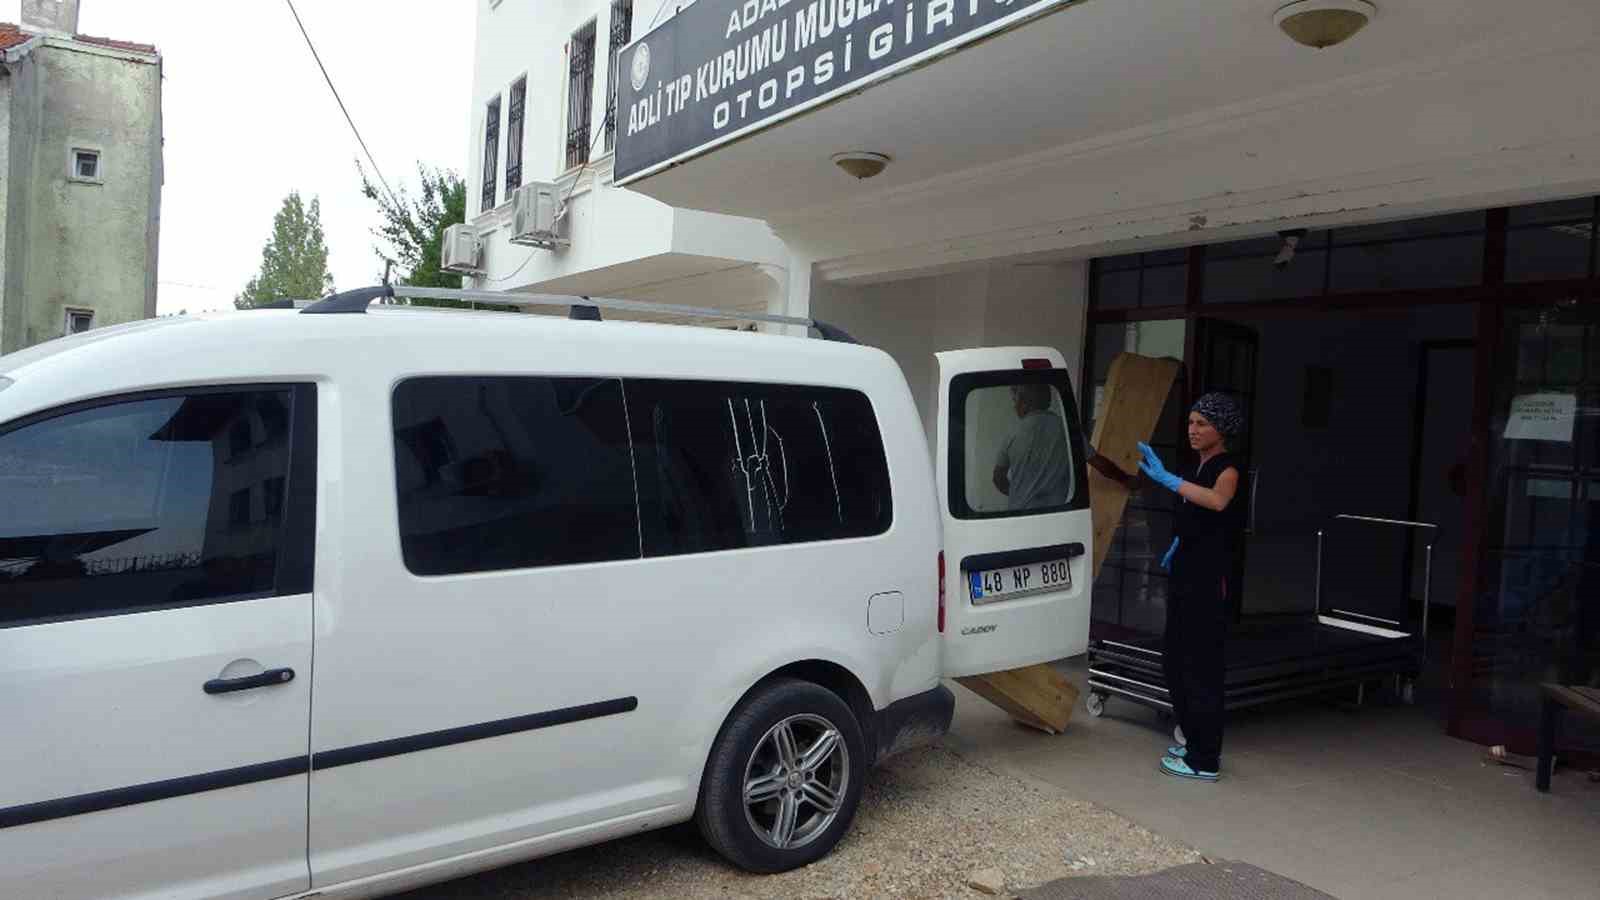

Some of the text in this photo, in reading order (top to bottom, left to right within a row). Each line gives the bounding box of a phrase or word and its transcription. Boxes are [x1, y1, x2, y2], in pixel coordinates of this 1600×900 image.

[627, 80, 662, 137] ADLİ
[665, 73, 693, 117] TIP
[695, 18, 788, 103] KURUMU
[712, 33, 852, 130] OTOPSİ
[984, 561, 1068, 593] 48 NP 880
